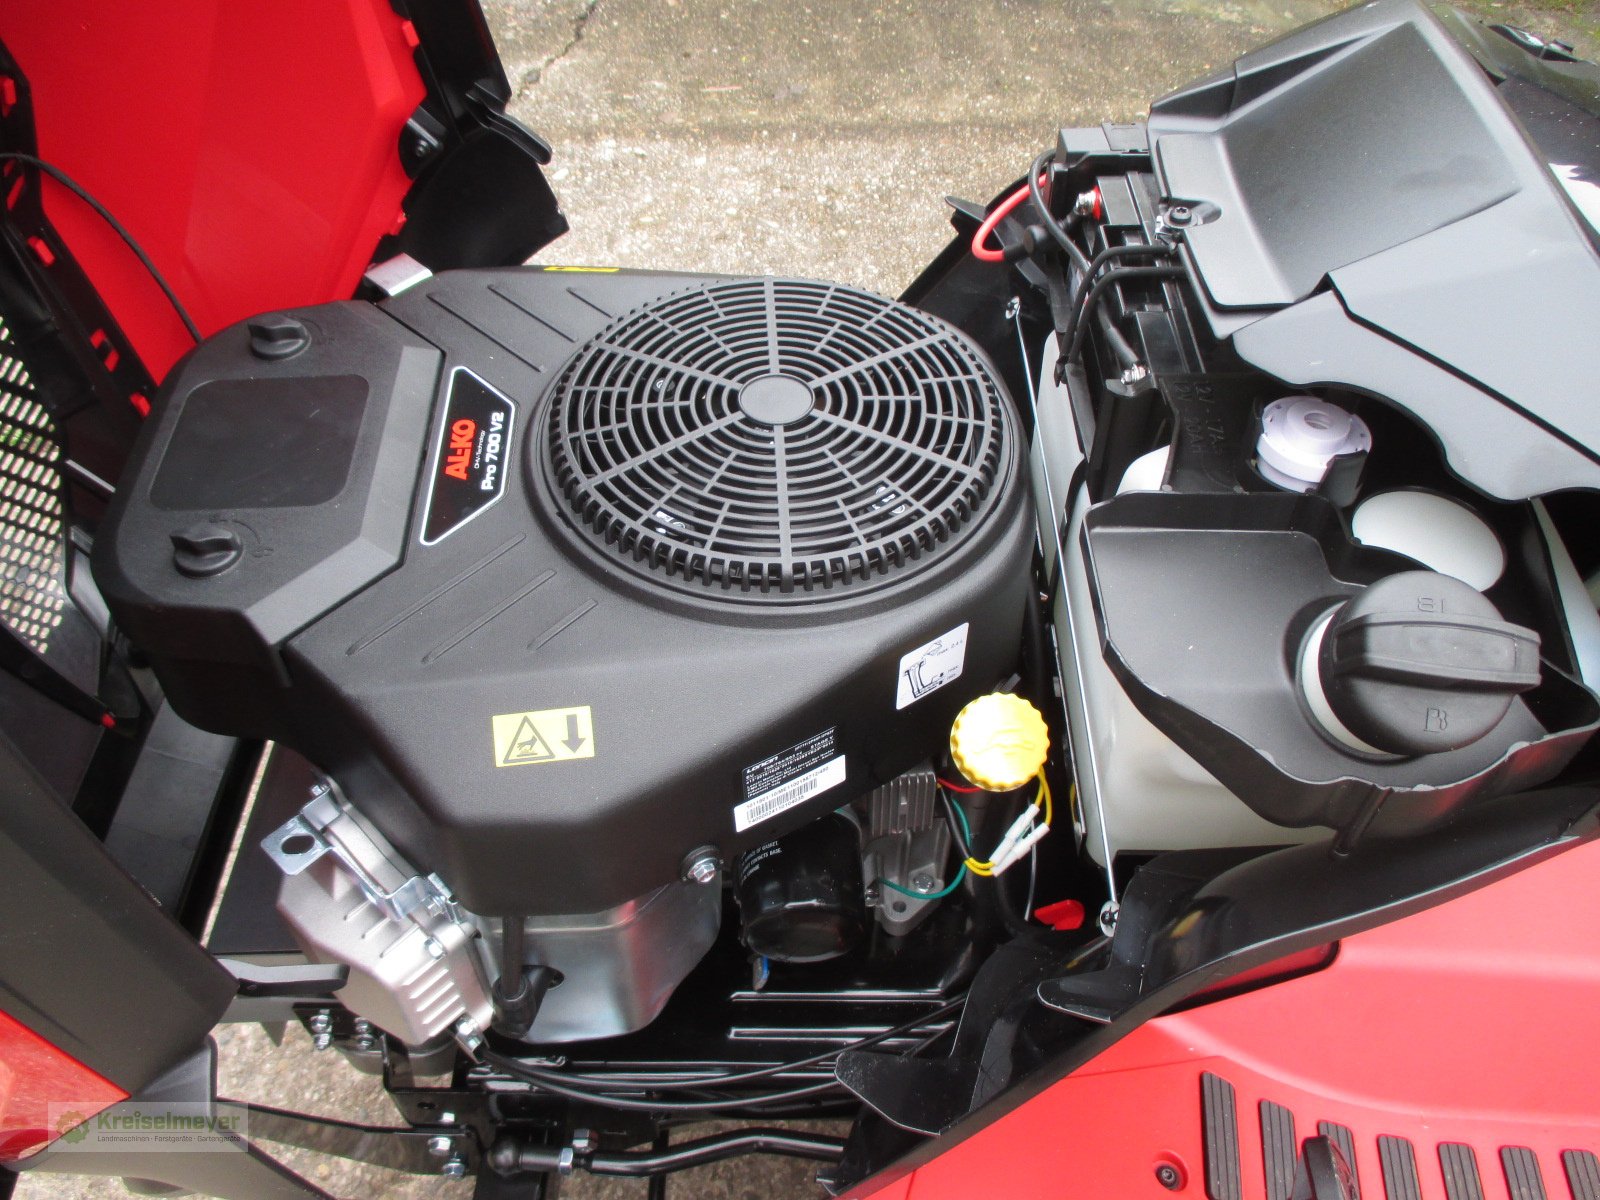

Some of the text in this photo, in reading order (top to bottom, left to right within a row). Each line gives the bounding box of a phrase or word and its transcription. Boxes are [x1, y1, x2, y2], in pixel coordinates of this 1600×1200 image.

[445, 419, 476, 480] AL-KO
[481, 411, 505, 490] Pro 700 V2
